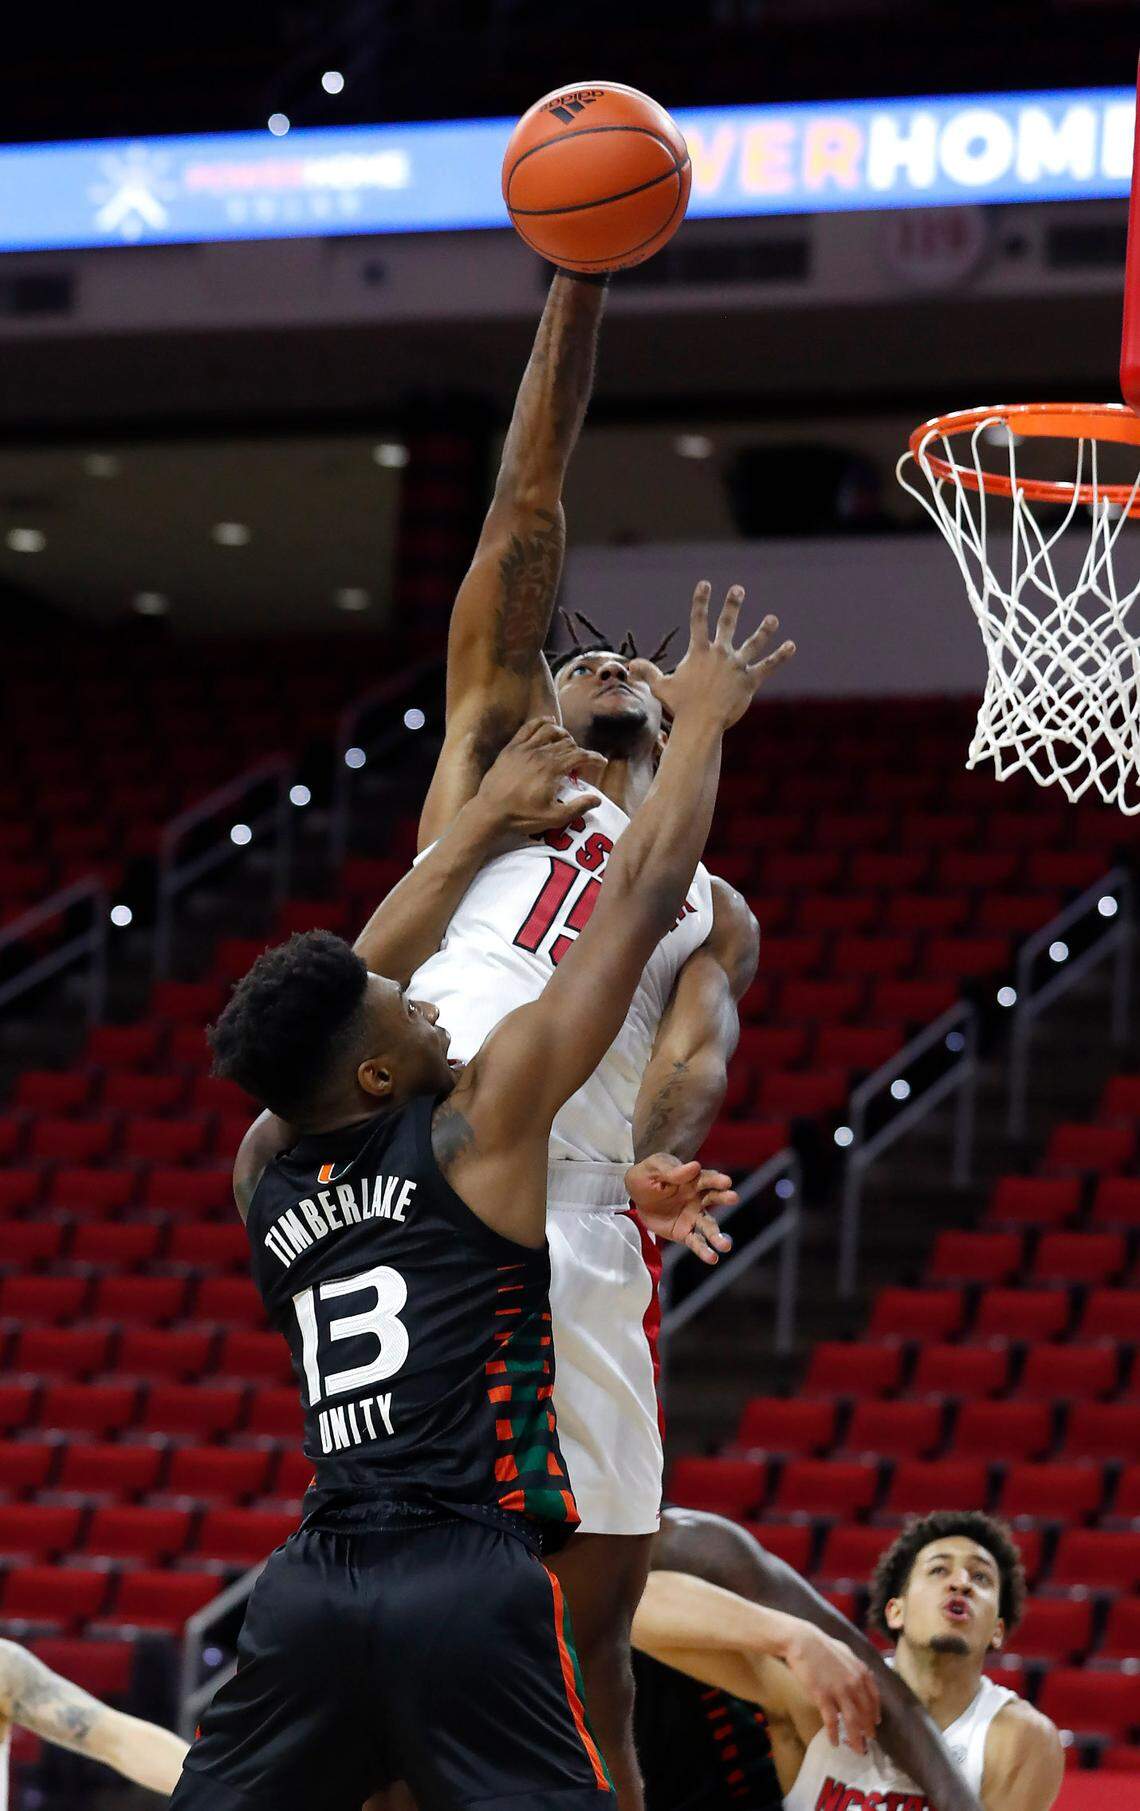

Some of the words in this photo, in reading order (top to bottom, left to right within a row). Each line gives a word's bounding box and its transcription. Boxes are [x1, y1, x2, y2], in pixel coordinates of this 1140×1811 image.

[539, 88, 605, 112] adidas
[264, 1175, 417, 1268] TIMBERLAKE
[292, 1265, 409, 1407] 13
[318, 1393, 394, 1454] UNITY
